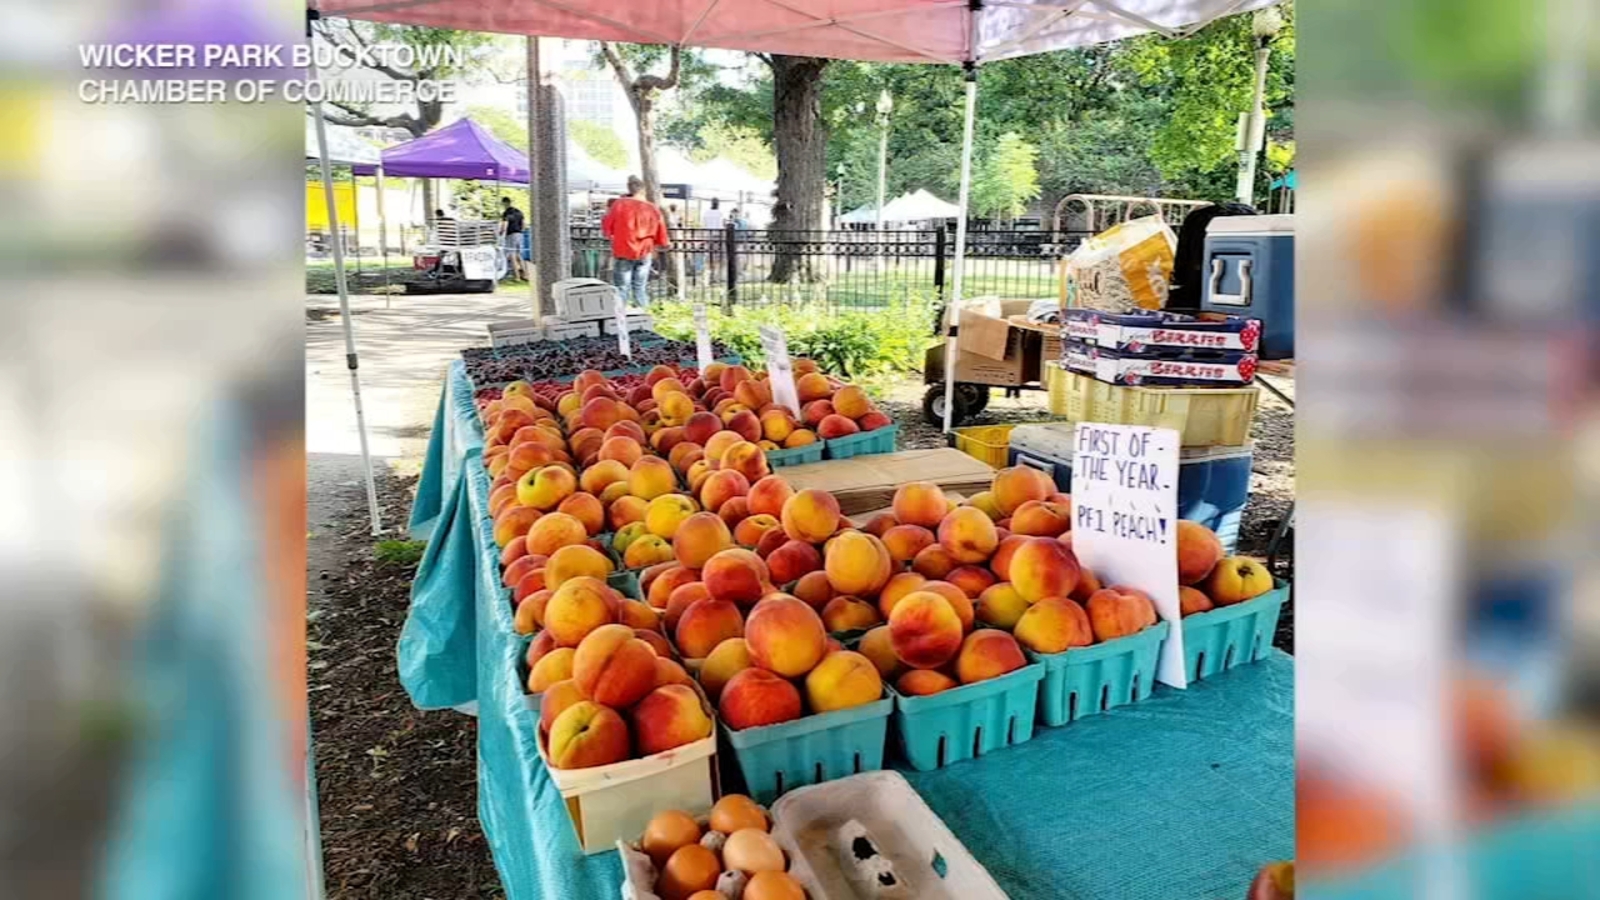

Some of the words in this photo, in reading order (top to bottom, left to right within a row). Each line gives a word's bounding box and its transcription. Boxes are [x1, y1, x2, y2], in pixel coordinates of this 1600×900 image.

[1079, 426, 1121, 456] FIRST
[1129, 432, 1151, 457] OF
[1080, 455, 1110, 480] THE
[1115, 460, 1161, 491] YEAR
[1113, 511, 1167, 544] PEACH!
